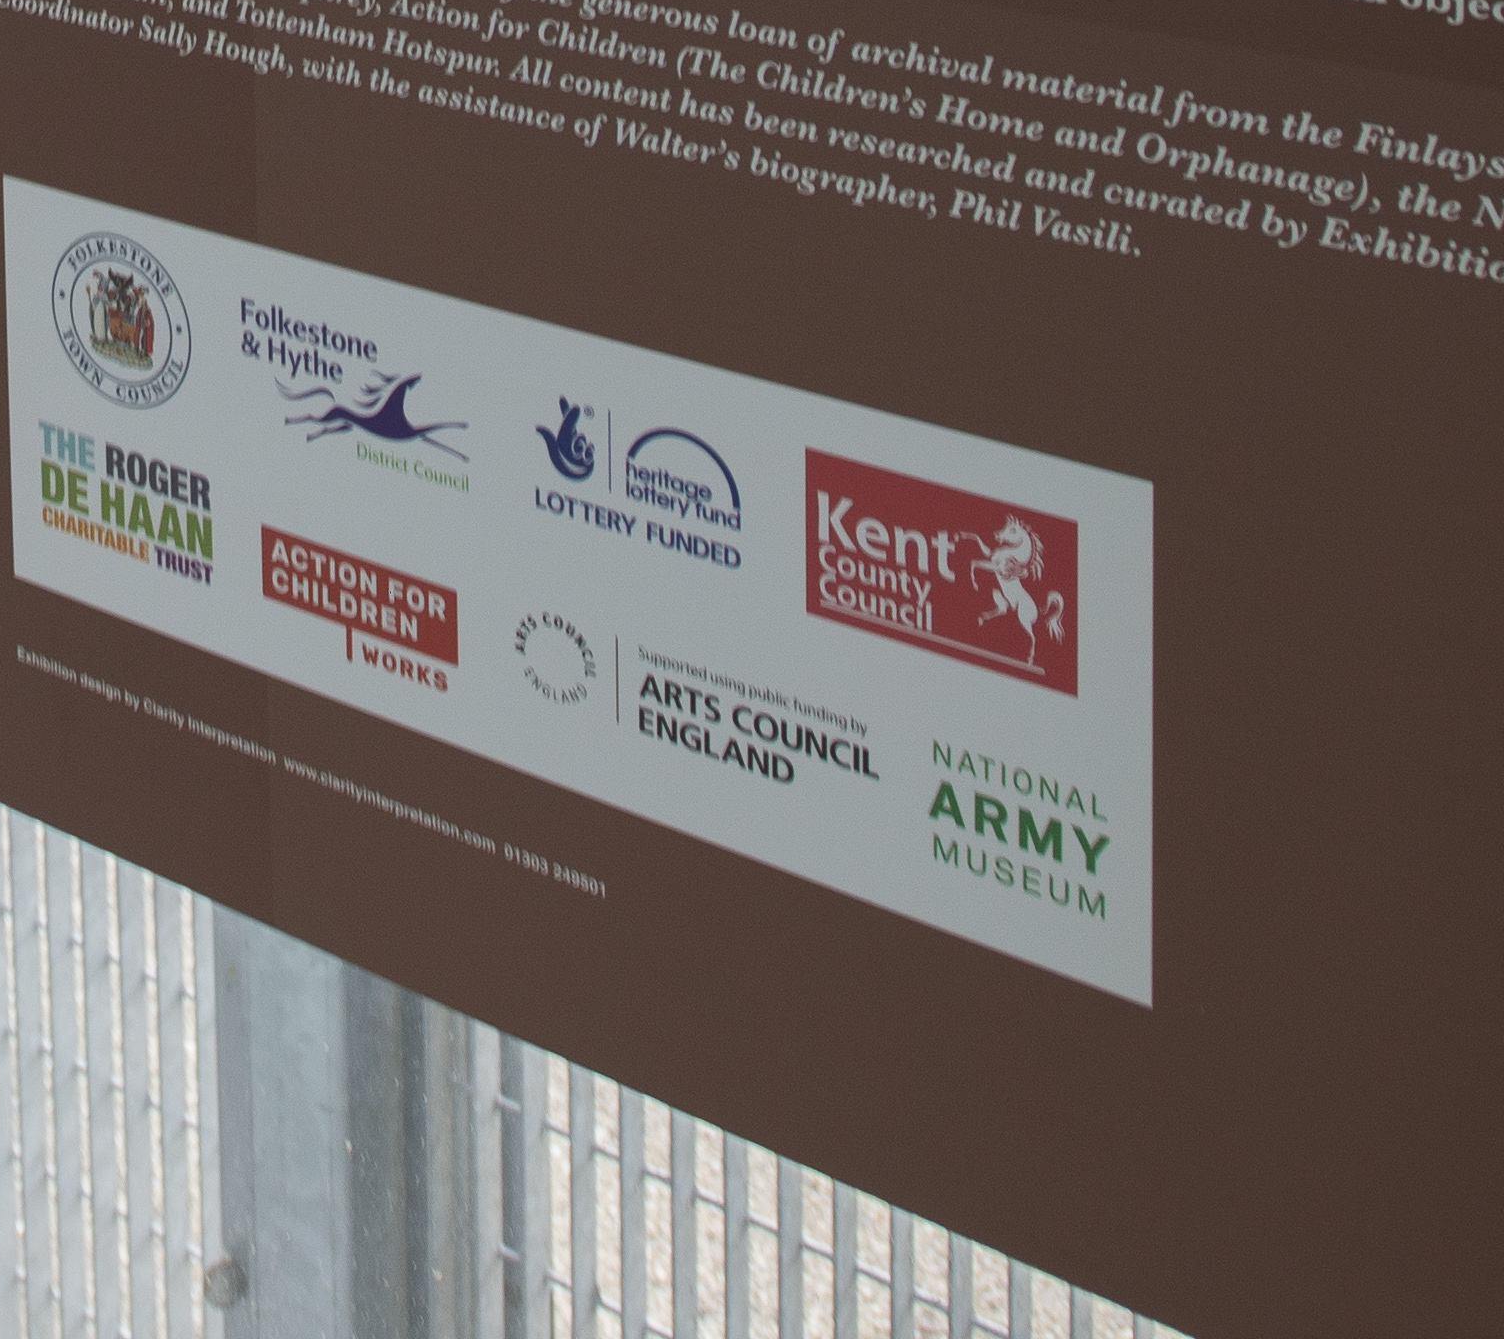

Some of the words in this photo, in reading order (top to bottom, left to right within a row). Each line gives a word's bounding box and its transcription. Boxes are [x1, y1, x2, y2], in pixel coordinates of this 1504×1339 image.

[67, 237, 174, 299] FOLKESTONE
[62, 325, 105, 387] TOWN
[115, 359, 184, 405] COUNCIL
[240, 297, 379, 363] Folkestone
[240, 332, 263, 361] &
[267, 337, 343, 384] Hythe
[39, 421, 96, 471] THE
[104, 443, 213, 511] ROGER
[356, 440, 409, 474] District
[413, 457, 471, 493] Council
[625, 461, 714, 502] heritage
[625, 479, 691, 519] lottery
[693, 496, 742, 532] fund
[40, 460, 89, 513] DE
[98, 477, 214, 561] HAAN
[41, 505, 151, 565] CHARITABLE
[154, 544, 214, 585] TRUST
[534, 485, 636, 539] LOTTERY
[645, 521, 742, 569] FUNDED
[816, 490, 958, 582] Kent
[270, 538, 380, 600] ACTION
[388, 575, 448, 620] FOR
[271, 568, 419, 642] CHILDREN
[818, 544, 932, 606] County
[818, 575, 934, 634] Council
[362, 641, 450, 693] WORKS
[638, 645, 708, 682] Supported
[710, 671, 746, 698] using
[748, 682, 790, 709] public
[793, 695, 848, 732] funding
[850, 715, 868, 739] by
[638, 704, 795, 784] ENGLAND
[639, 671, 722, 724] ARTS
[731, 703, 881, 781] COUNCIL
[933, 739, 1110, 822] NATIONAL
[928, 779, 1111, 878] ARMY
[933, 832, 1109, 921] MUSEUM
